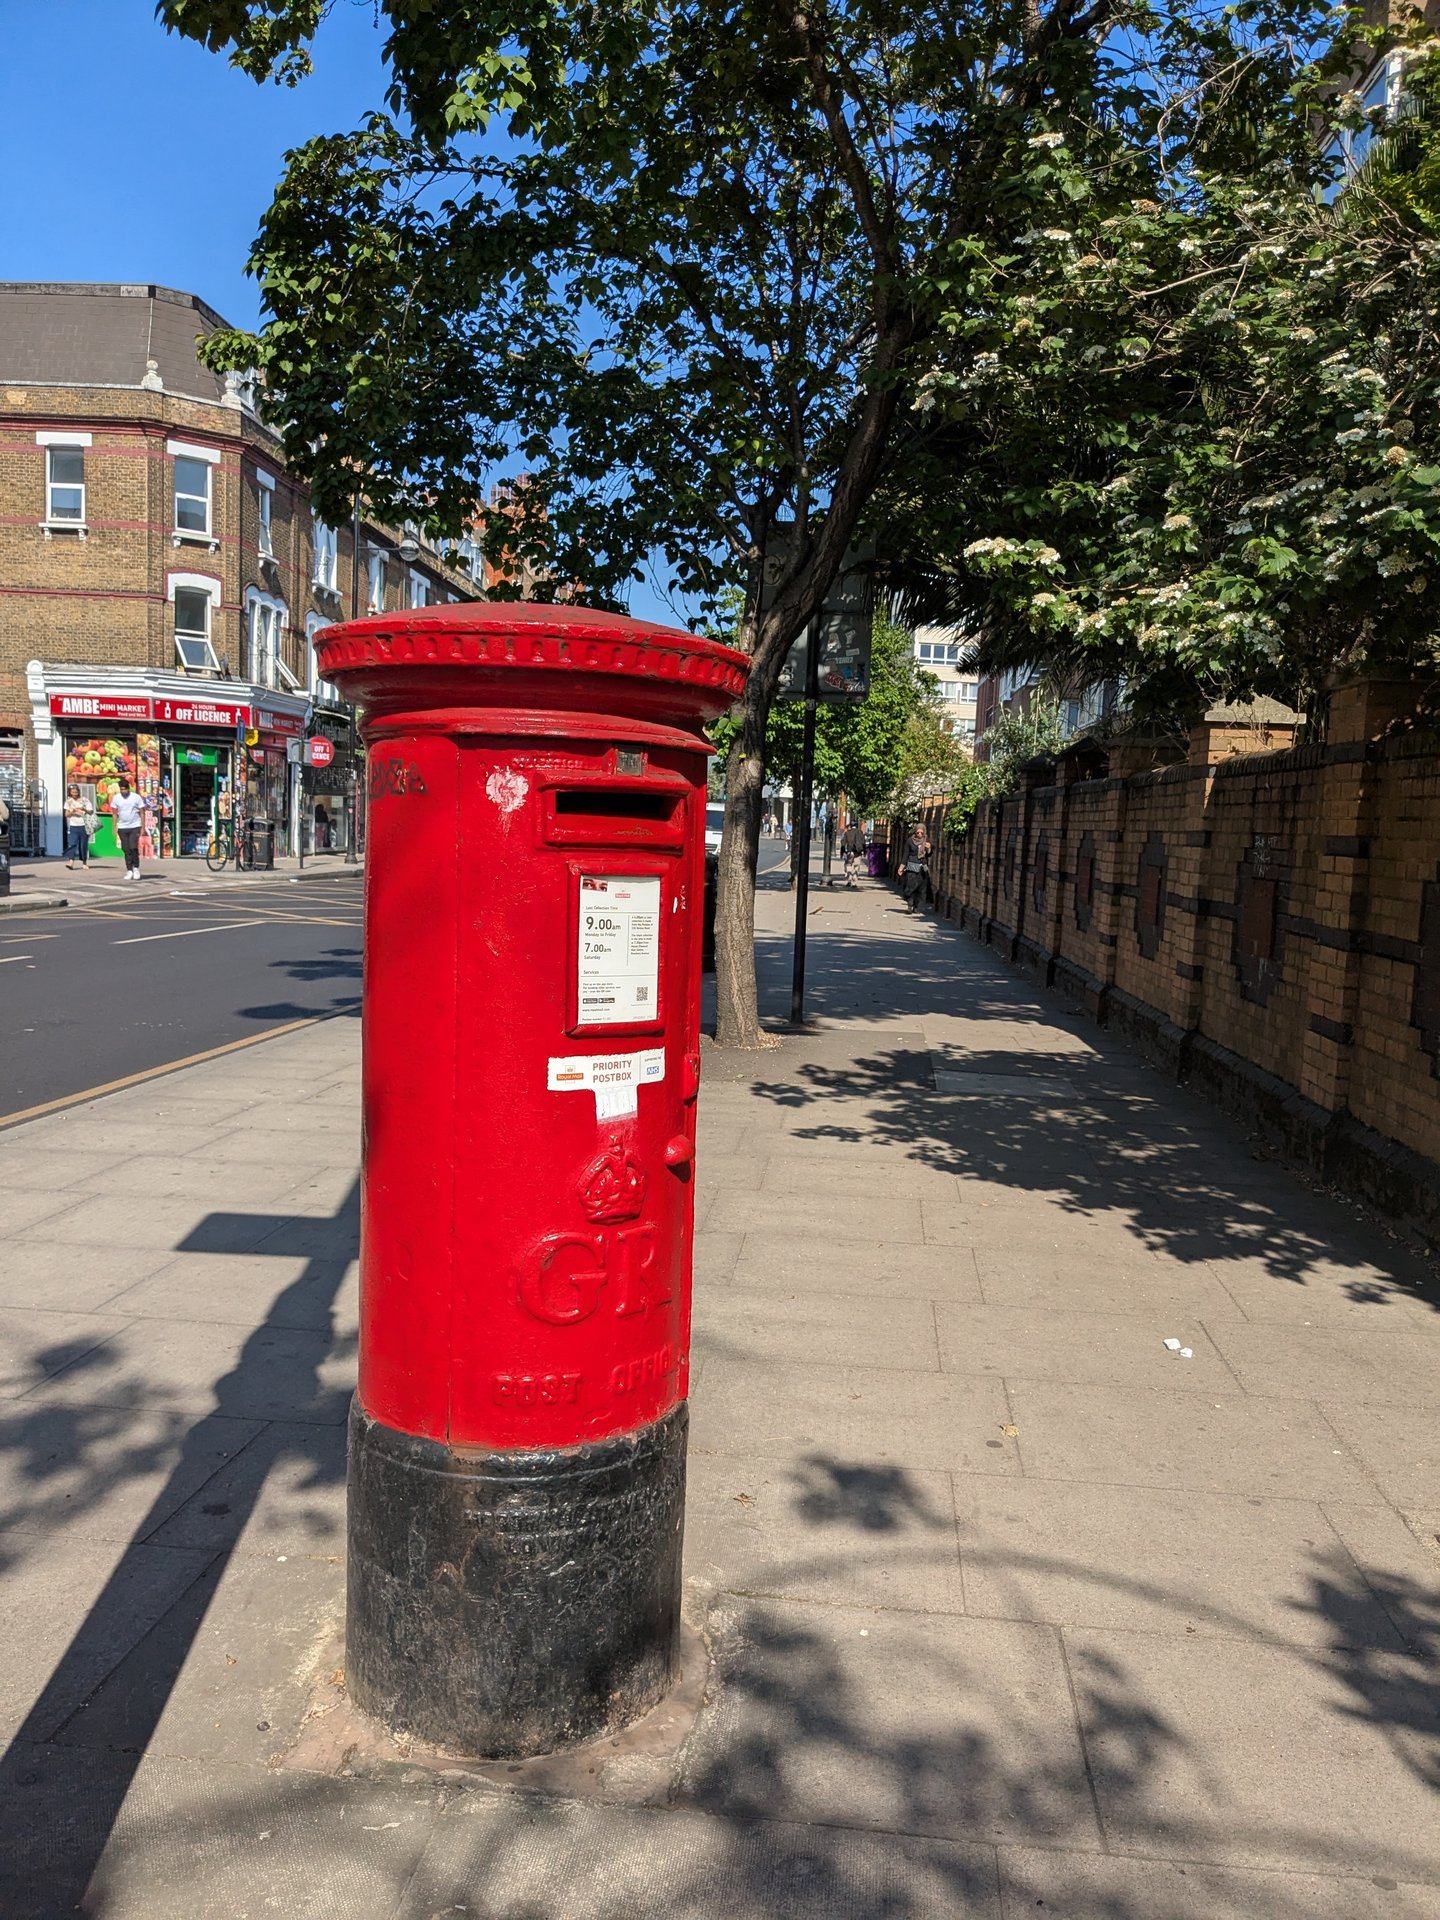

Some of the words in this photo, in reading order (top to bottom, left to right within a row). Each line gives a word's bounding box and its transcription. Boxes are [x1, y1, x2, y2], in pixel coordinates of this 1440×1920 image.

[62, 698, 100, 714] AMBE
[117, 704, 146, 712] MARKET
[176, 708, 192, 720] OFF
[194, 710, 231, 723] LICENCE
[586, 916, 622, 930] 9.00am
[584, 942, 612, 952] 7.00am
[592, 1060, 632, 1071] PRIORITY
[592, 1072, 632, 1083] POSTBOX
[492, 1372, 582, 1407] POST
